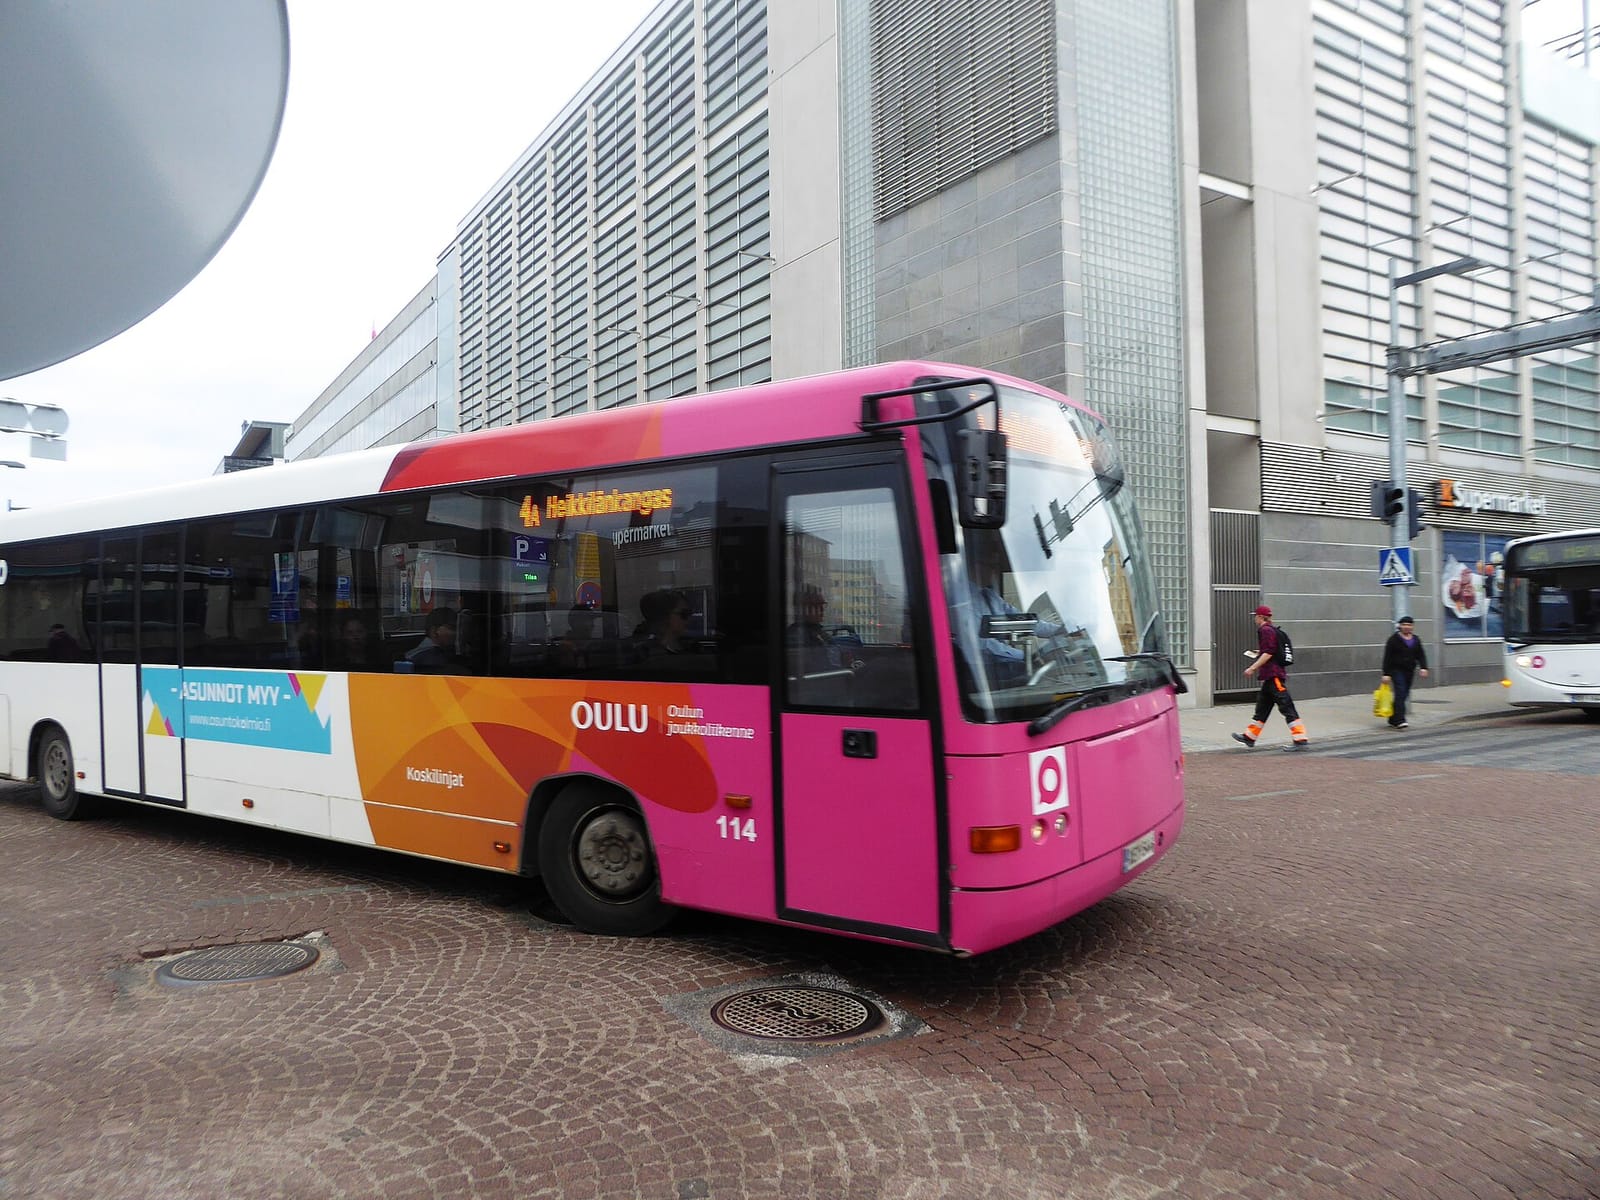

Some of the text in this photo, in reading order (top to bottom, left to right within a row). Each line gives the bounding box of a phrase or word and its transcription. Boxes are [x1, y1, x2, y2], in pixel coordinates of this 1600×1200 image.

[1453, 480, 1546, 515] Supermarket
[516, 540, 528, 559] P
[337, 577, 347, 589] P
[179, 681, 280, 706] ASUNNOT MYY
[570, 700, 649, 733] OULU
[666, 704, 704, 719] Oulun
[665, 720, 755, 739] joukkoliikenne
[406, 766, 465, 789] Koskilinjat
[715, 815, 758, 842] 114
